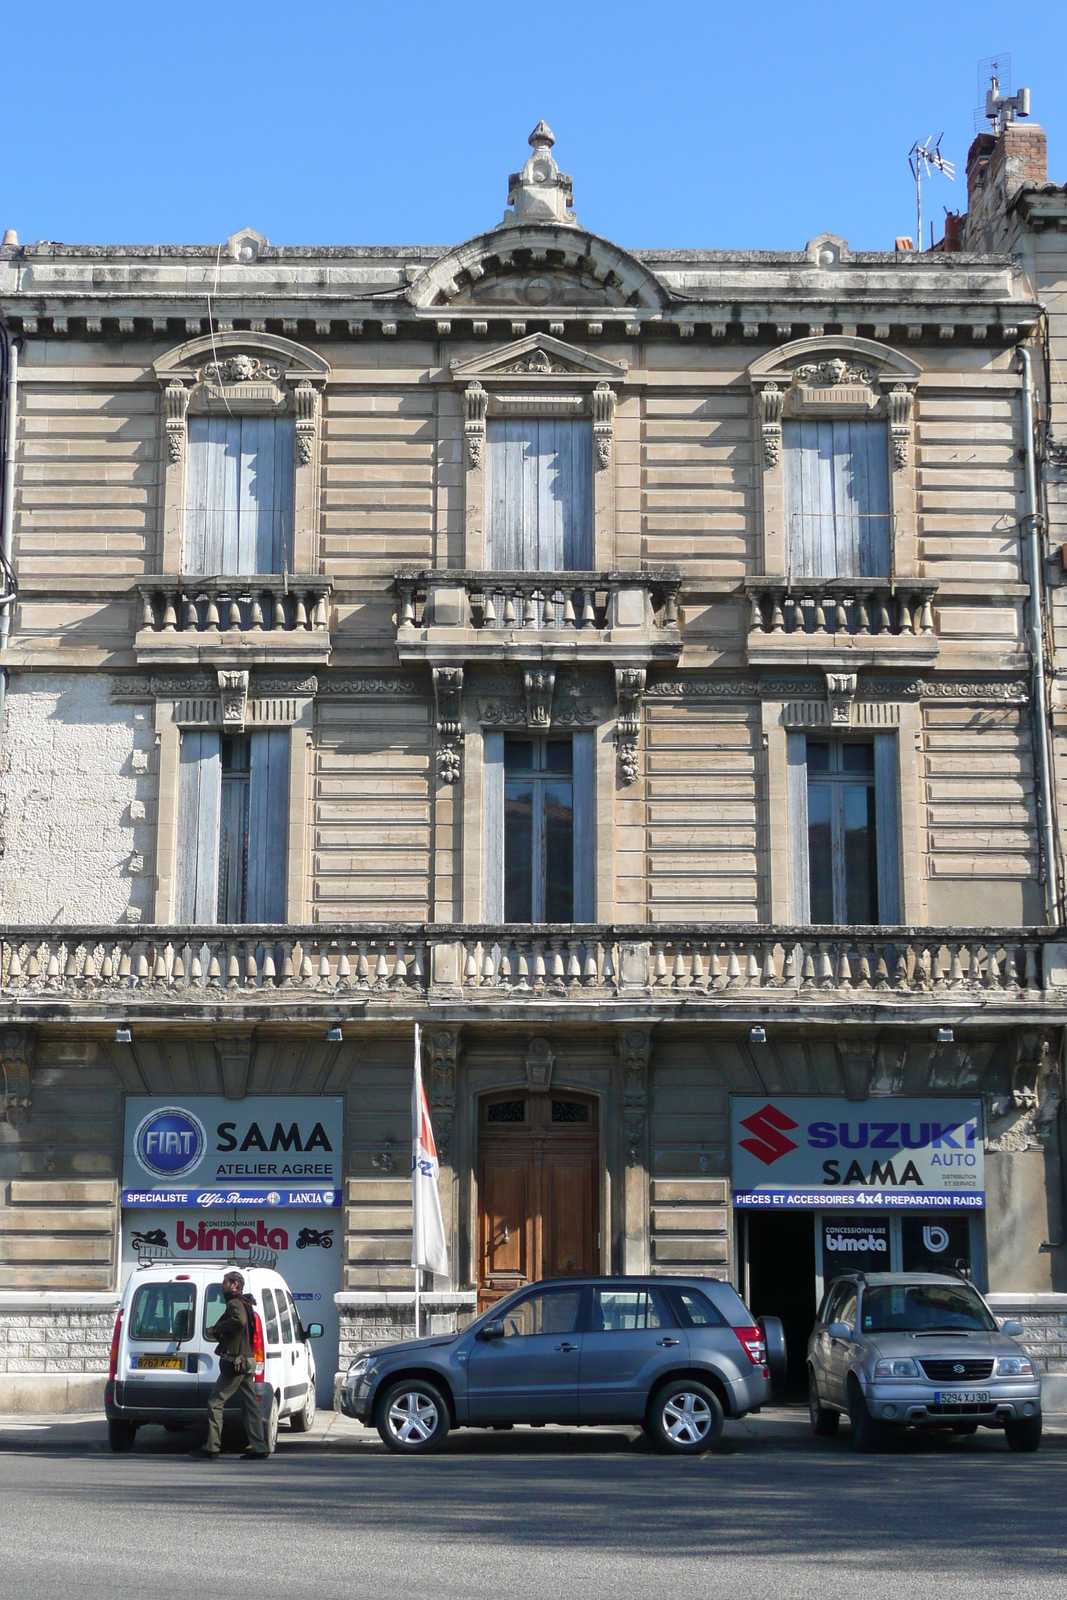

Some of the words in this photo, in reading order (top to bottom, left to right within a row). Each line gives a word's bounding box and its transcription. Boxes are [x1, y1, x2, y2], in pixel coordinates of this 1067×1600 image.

[146, 1131, 194, 1154] FIAT
[216, 1122, 333, 1152] SAMA
[807, 1121, 976, 1149] SUZUKI
[930, 1153, 976, 1166] AUTO
[216, 1164, 277, 1174] ATELIER
[281, 1164, 333, 1174] AGREE
[822, 1159, 924, 1186] SAMA
[127, 1194, 188, 1203] SPECIALISTE
[196, 1193, 226, 1208] Alfa
[226, 1192, 267, 1204] Romeo
[289, 1193, 323, 1204] LANCIA
[736, 1195, 771, 1204] PIECES
[772, 1195, 786, 1204] ET
[787, 1195, 855, 1204] ACCESSOIRES
[856, 1192, 883, 1205] 4x4
[884, 1195, 951, 1206] PREPARATION
[953, 1196, 983, 1206] RAIDS
[176, 1219, 289, 1251] bimota
[826, 1234, 887, 1251] bimota
[941, 1393, 963, 1403] 5294
[976, 1393, 988, 1403] 30
